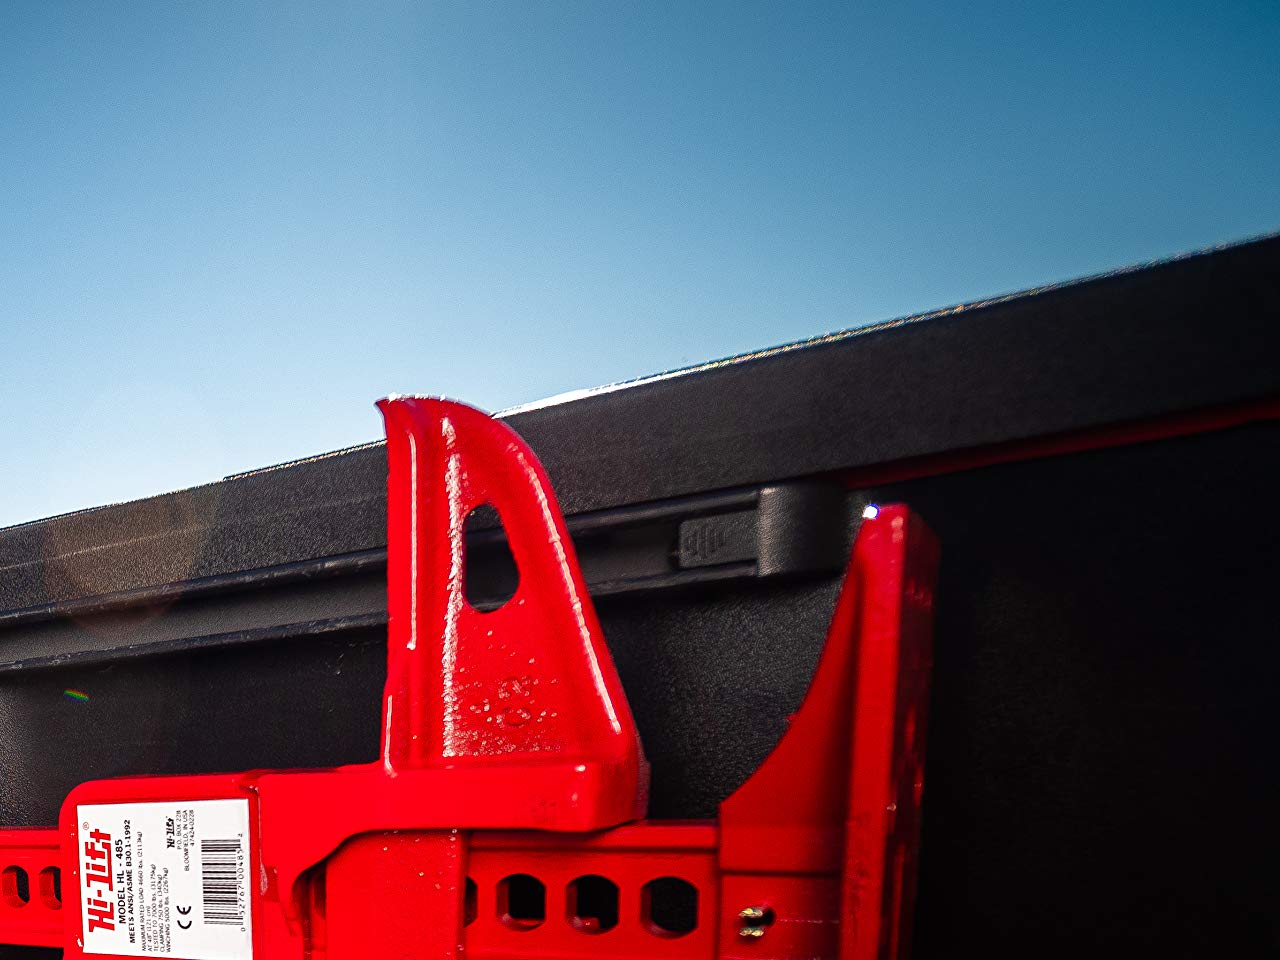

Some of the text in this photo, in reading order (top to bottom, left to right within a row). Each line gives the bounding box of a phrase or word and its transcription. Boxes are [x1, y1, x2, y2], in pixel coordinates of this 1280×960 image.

[115, 839, 123, 859] 485
[124, 820, 132, 866] B30.1-1992
[117, 871, 124, 883] HL
[127, 870, 135, 914] ANSI/ASME
[117, 888, 126, 924] MODEL
